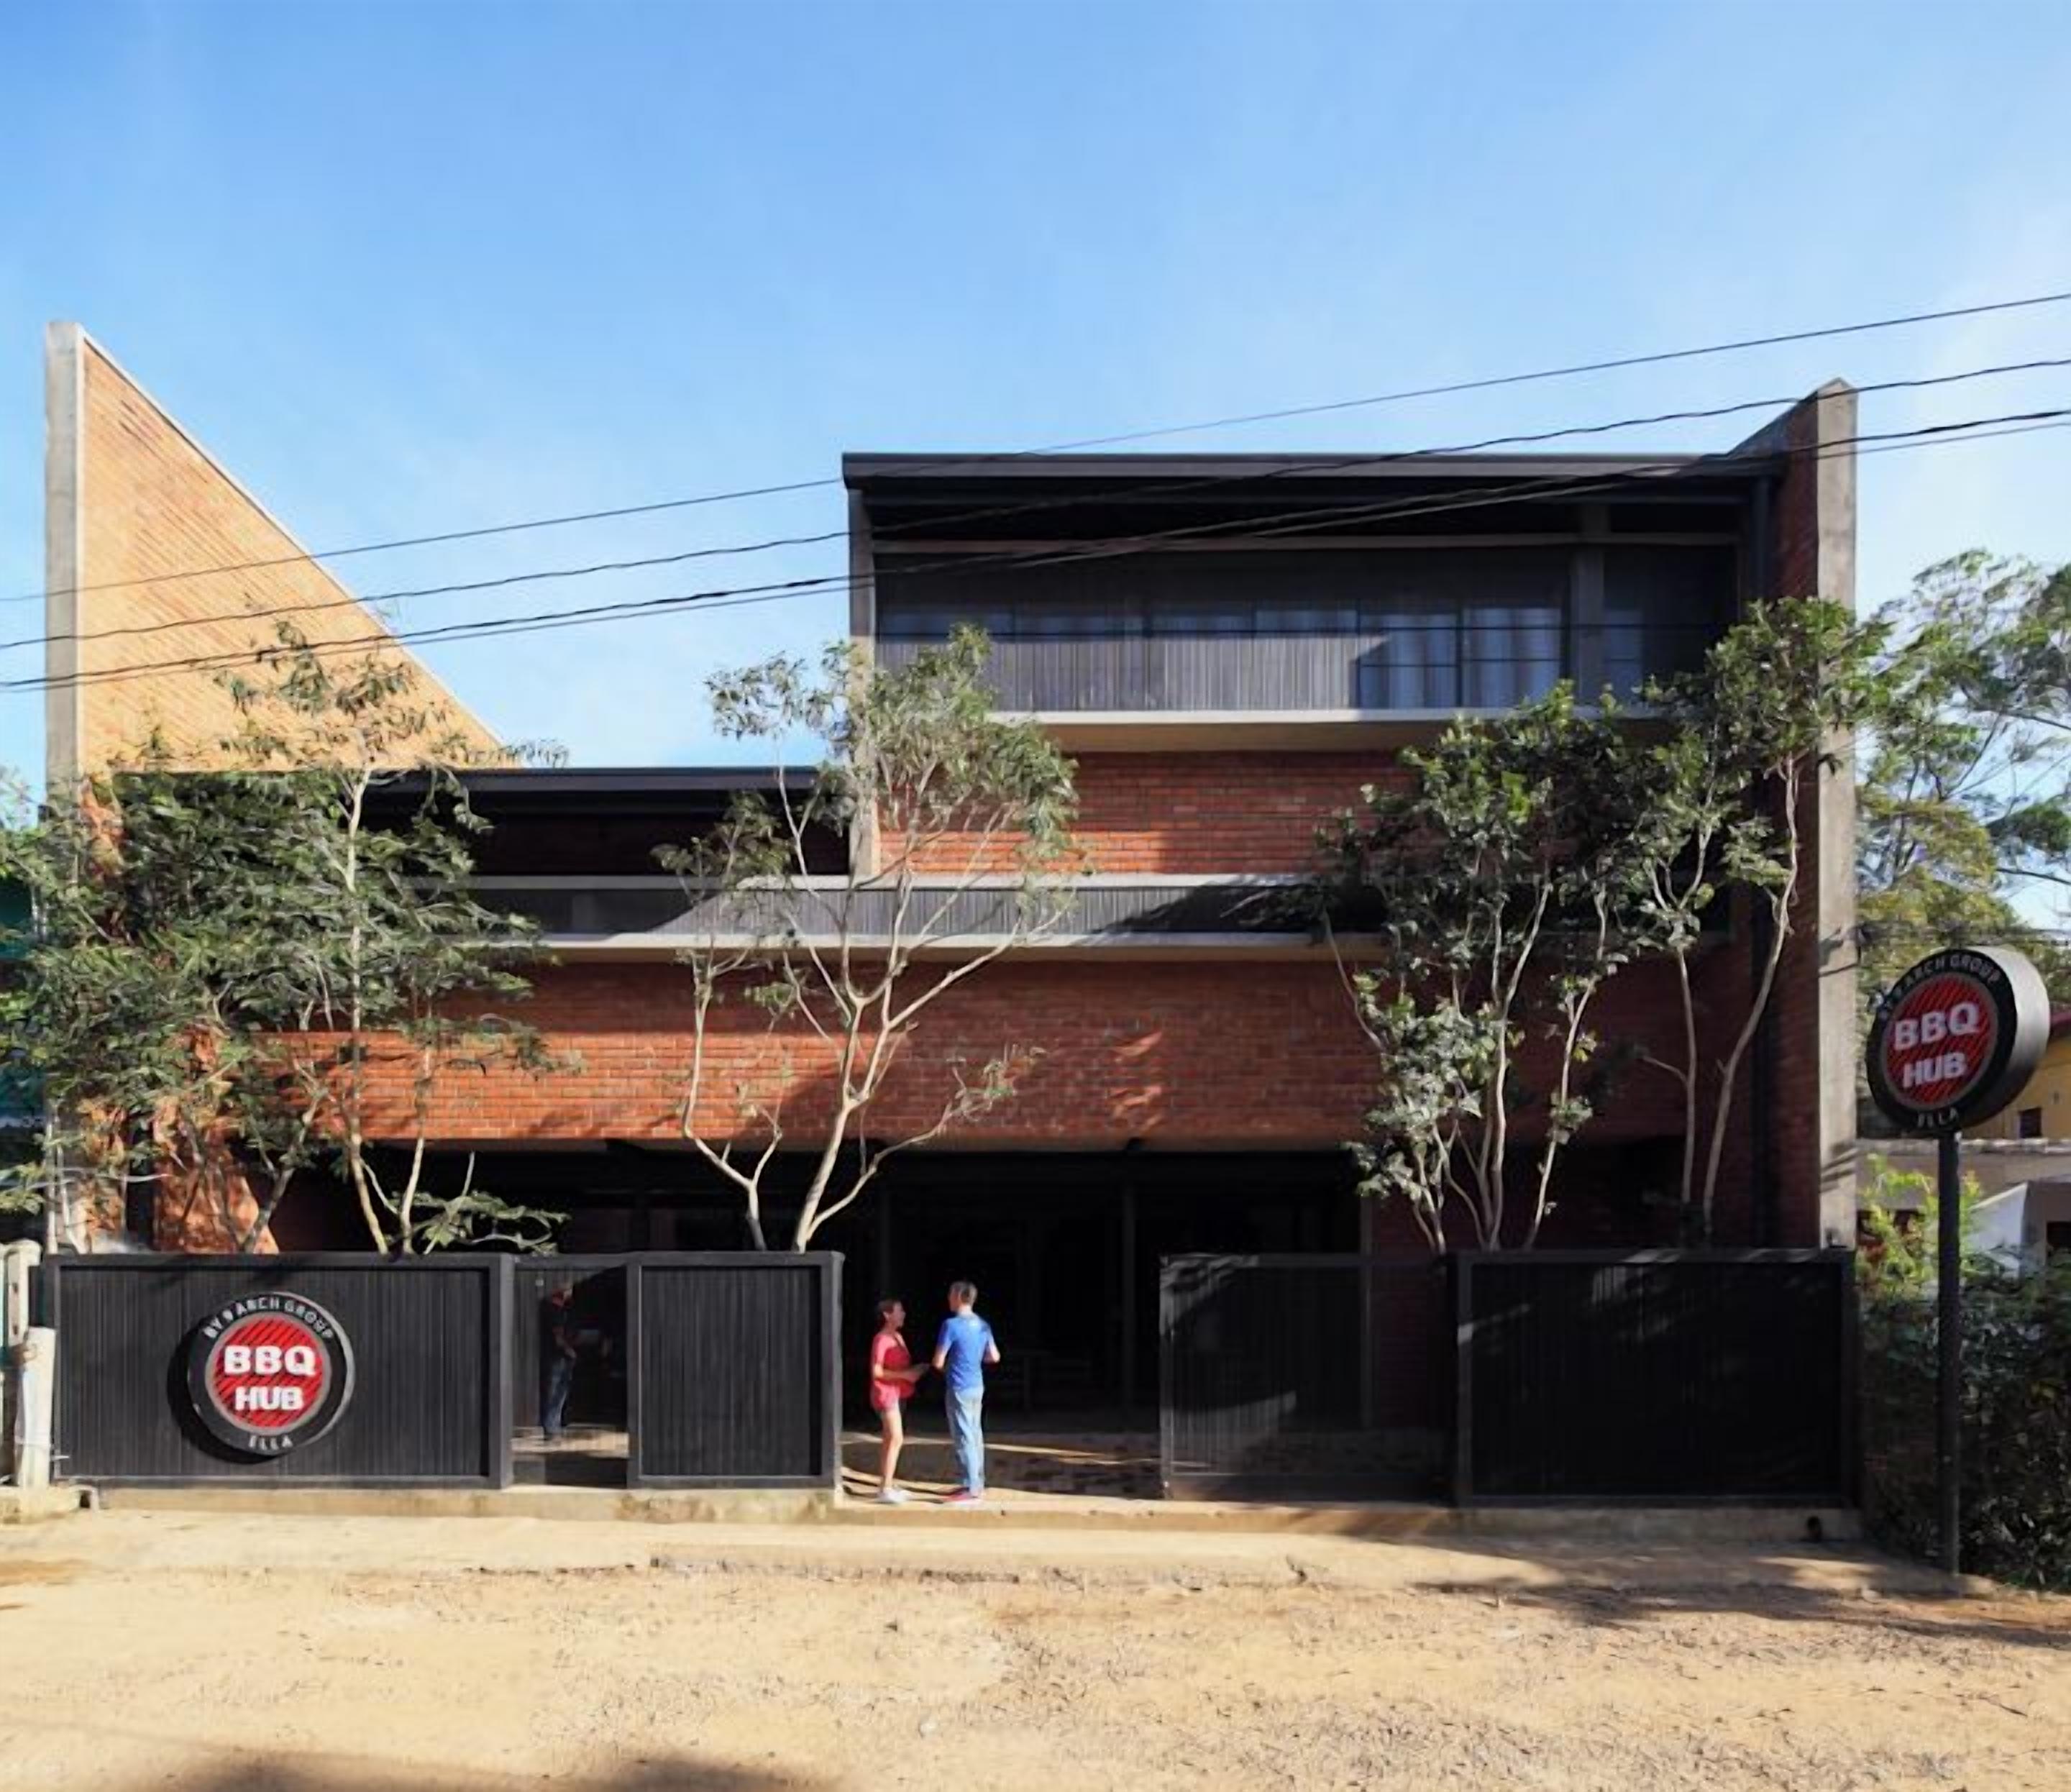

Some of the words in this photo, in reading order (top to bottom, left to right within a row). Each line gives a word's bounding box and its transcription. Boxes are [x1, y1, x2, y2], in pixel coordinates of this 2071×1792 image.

[1949, 954, 2001, 985] GROUP
[1893, 1002, 1979, 1051] BBQ
[1902, 1051, 1968, 1088] HUB
[284, 1299, 334, 1338] GROUP
[224, 1345, 316, 1377] BBQ
[234, 1386, 305, 1411] HUB
[248, 1435, 293, 1451] ELLA
